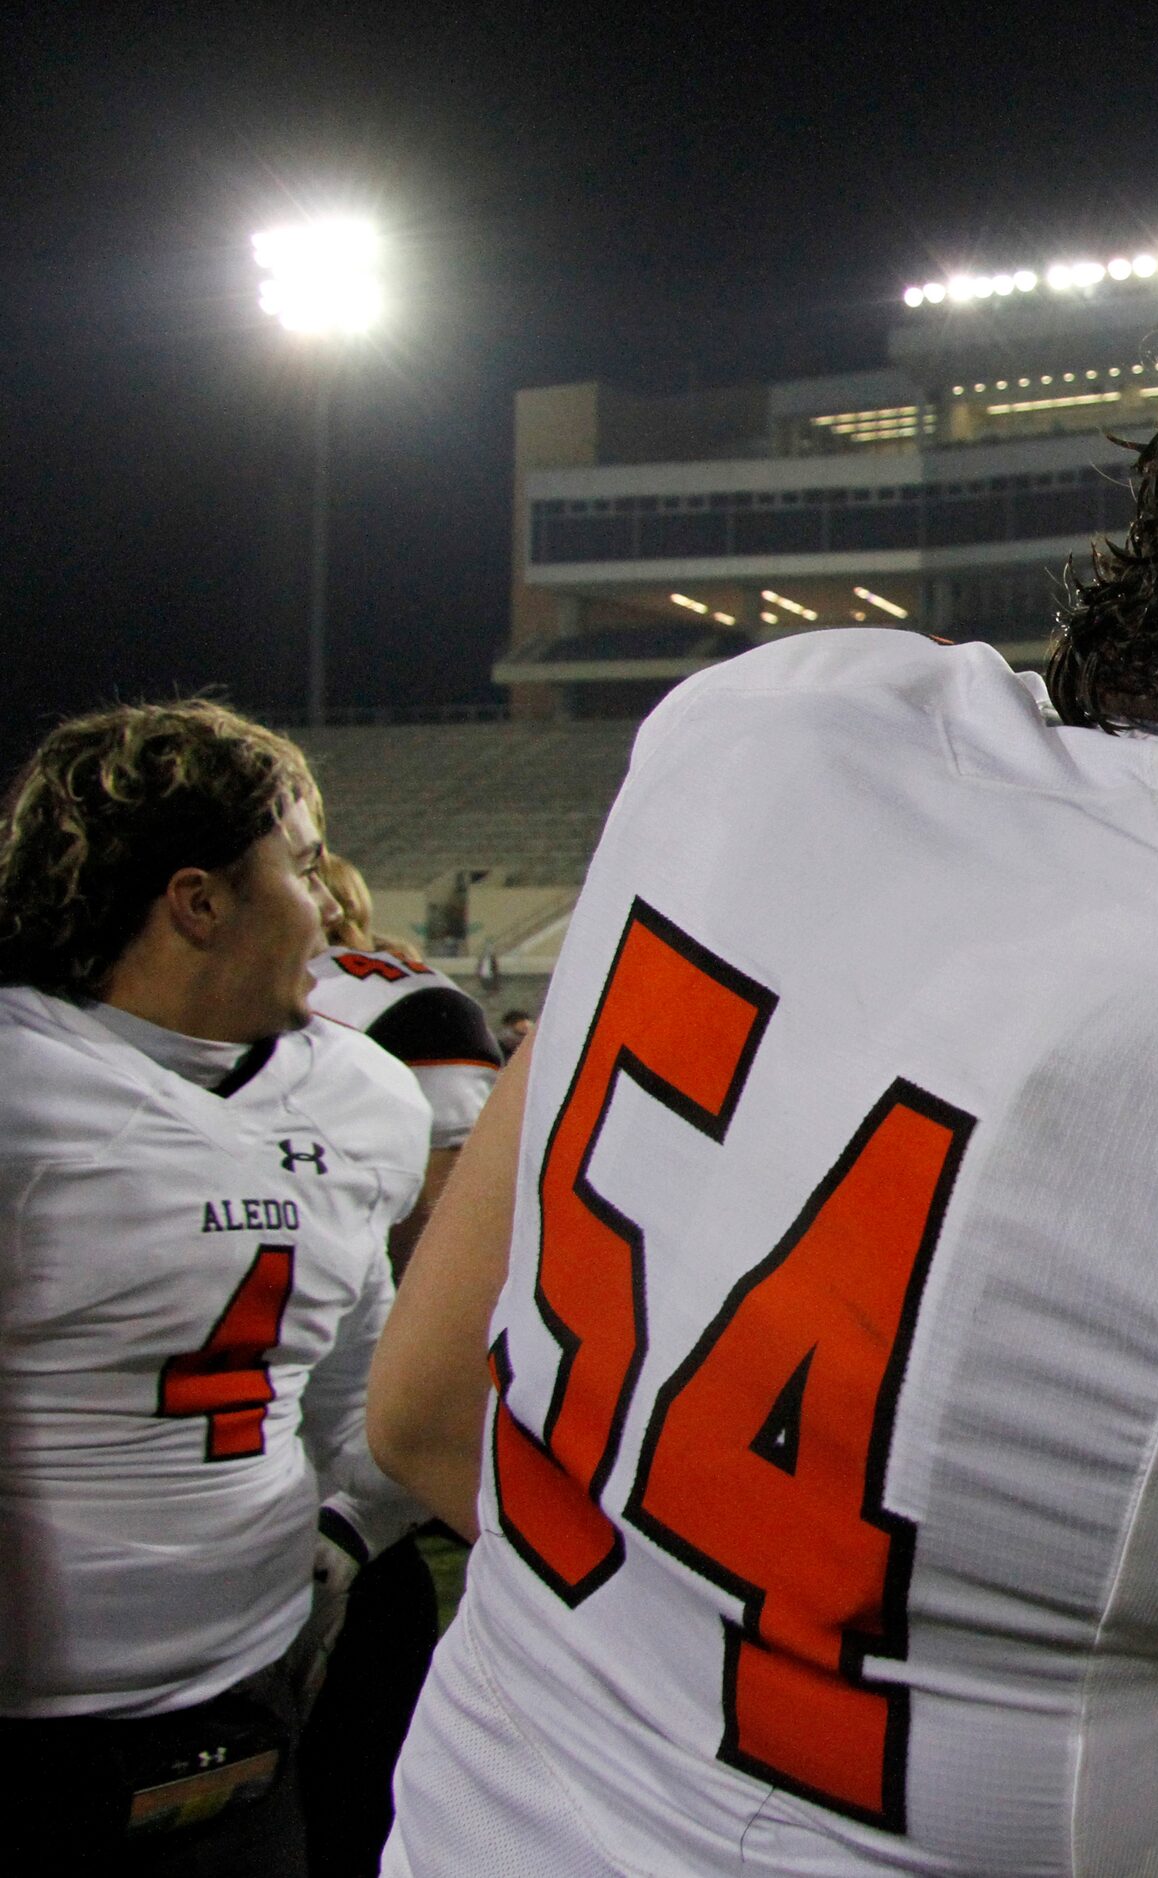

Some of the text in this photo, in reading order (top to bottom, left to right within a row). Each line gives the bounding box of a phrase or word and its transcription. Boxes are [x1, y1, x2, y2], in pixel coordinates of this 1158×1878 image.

[202, 1199, 300, 1232] ALEDO
[156, 1243, 296, 1463] 4
[488, 895, 977, 1835] 54
